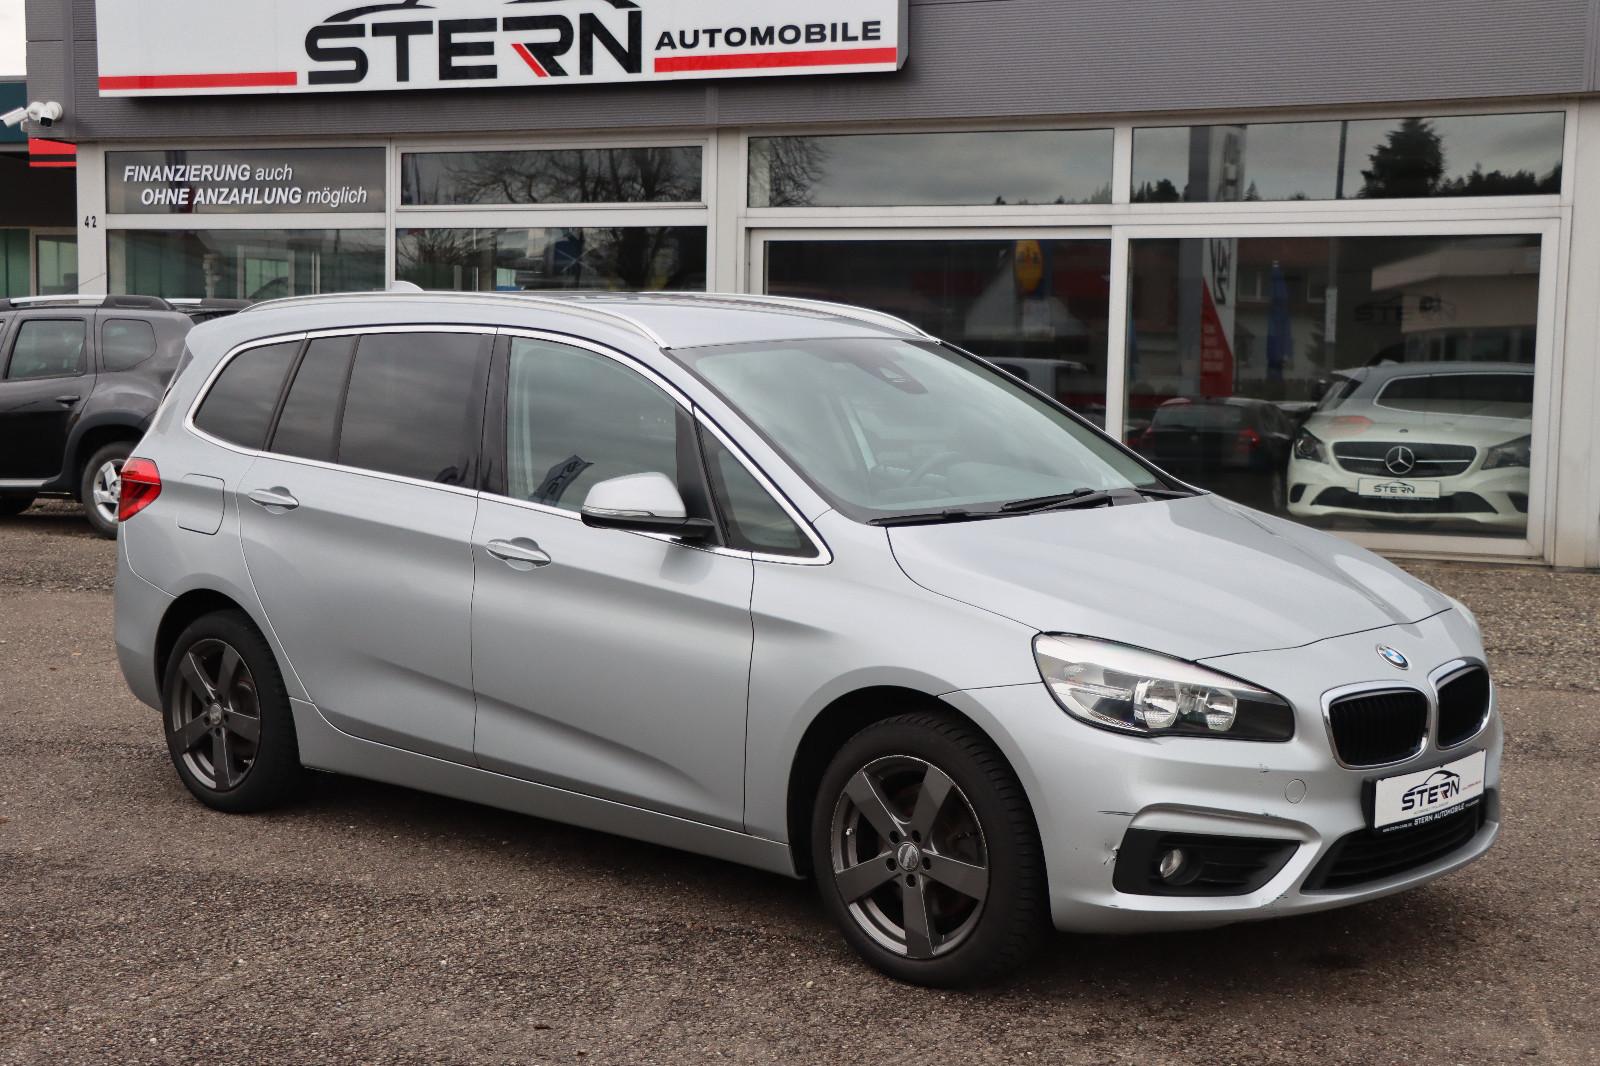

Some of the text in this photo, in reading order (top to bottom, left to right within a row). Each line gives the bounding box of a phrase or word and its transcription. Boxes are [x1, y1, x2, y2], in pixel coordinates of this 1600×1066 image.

[305, 11, 881, 85] STERN AUTOMOBILE
[124, 163, 293, 183] FINANZIERUNG auch
[141, 186, 368, 208] OHNE ANZAHLUNG möglich
[84, 215, 97, 229] 42
[1374, 486, 1415, 494] STERN
[1401, 778, 1460, 811] STERN
[1413, 815, 1433, 826] STERN
[1434, 803, 1465, 819] AUTOMOBILE
